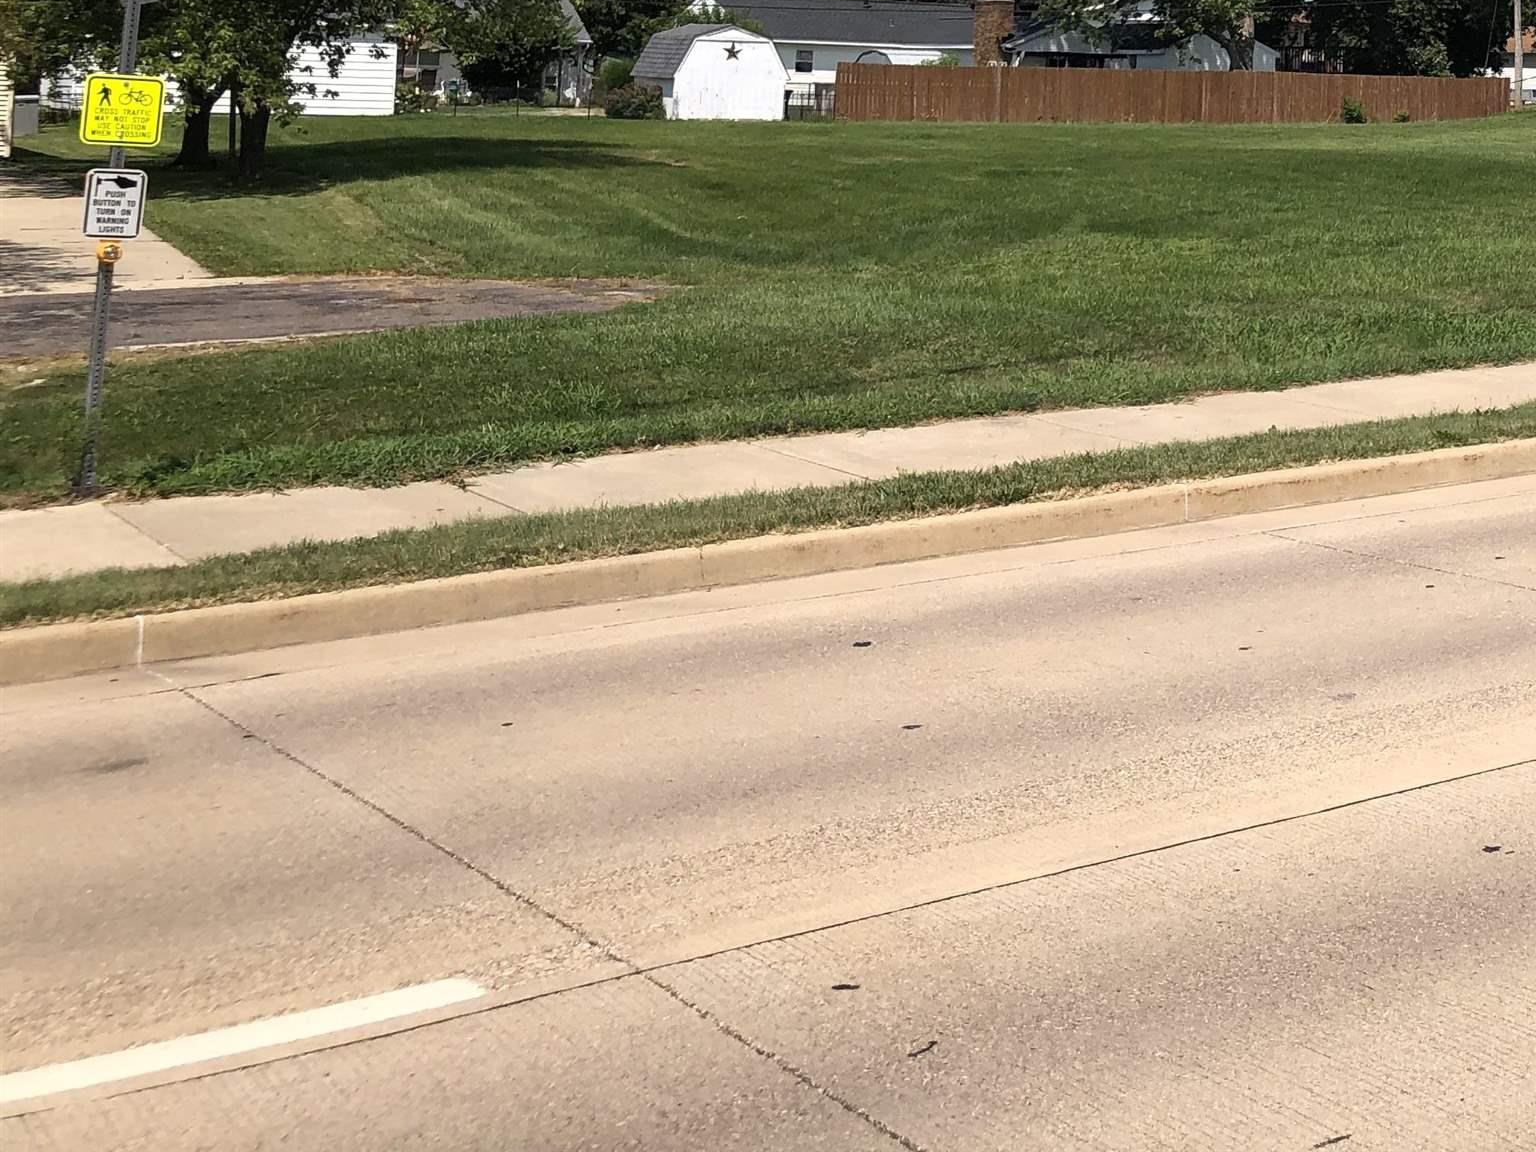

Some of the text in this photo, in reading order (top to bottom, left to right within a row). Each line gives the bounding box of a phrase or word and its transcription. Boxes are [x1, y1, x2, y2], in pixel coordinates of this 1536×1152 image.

[105, 190, 126, 198] PUSH
[93, 198, 121, 206] BUTTON
[96, 207, 131, 216] TURN ON
[96, 216, 129, 224] WARNING
[98, 225, 124, 233] LIGHTS
